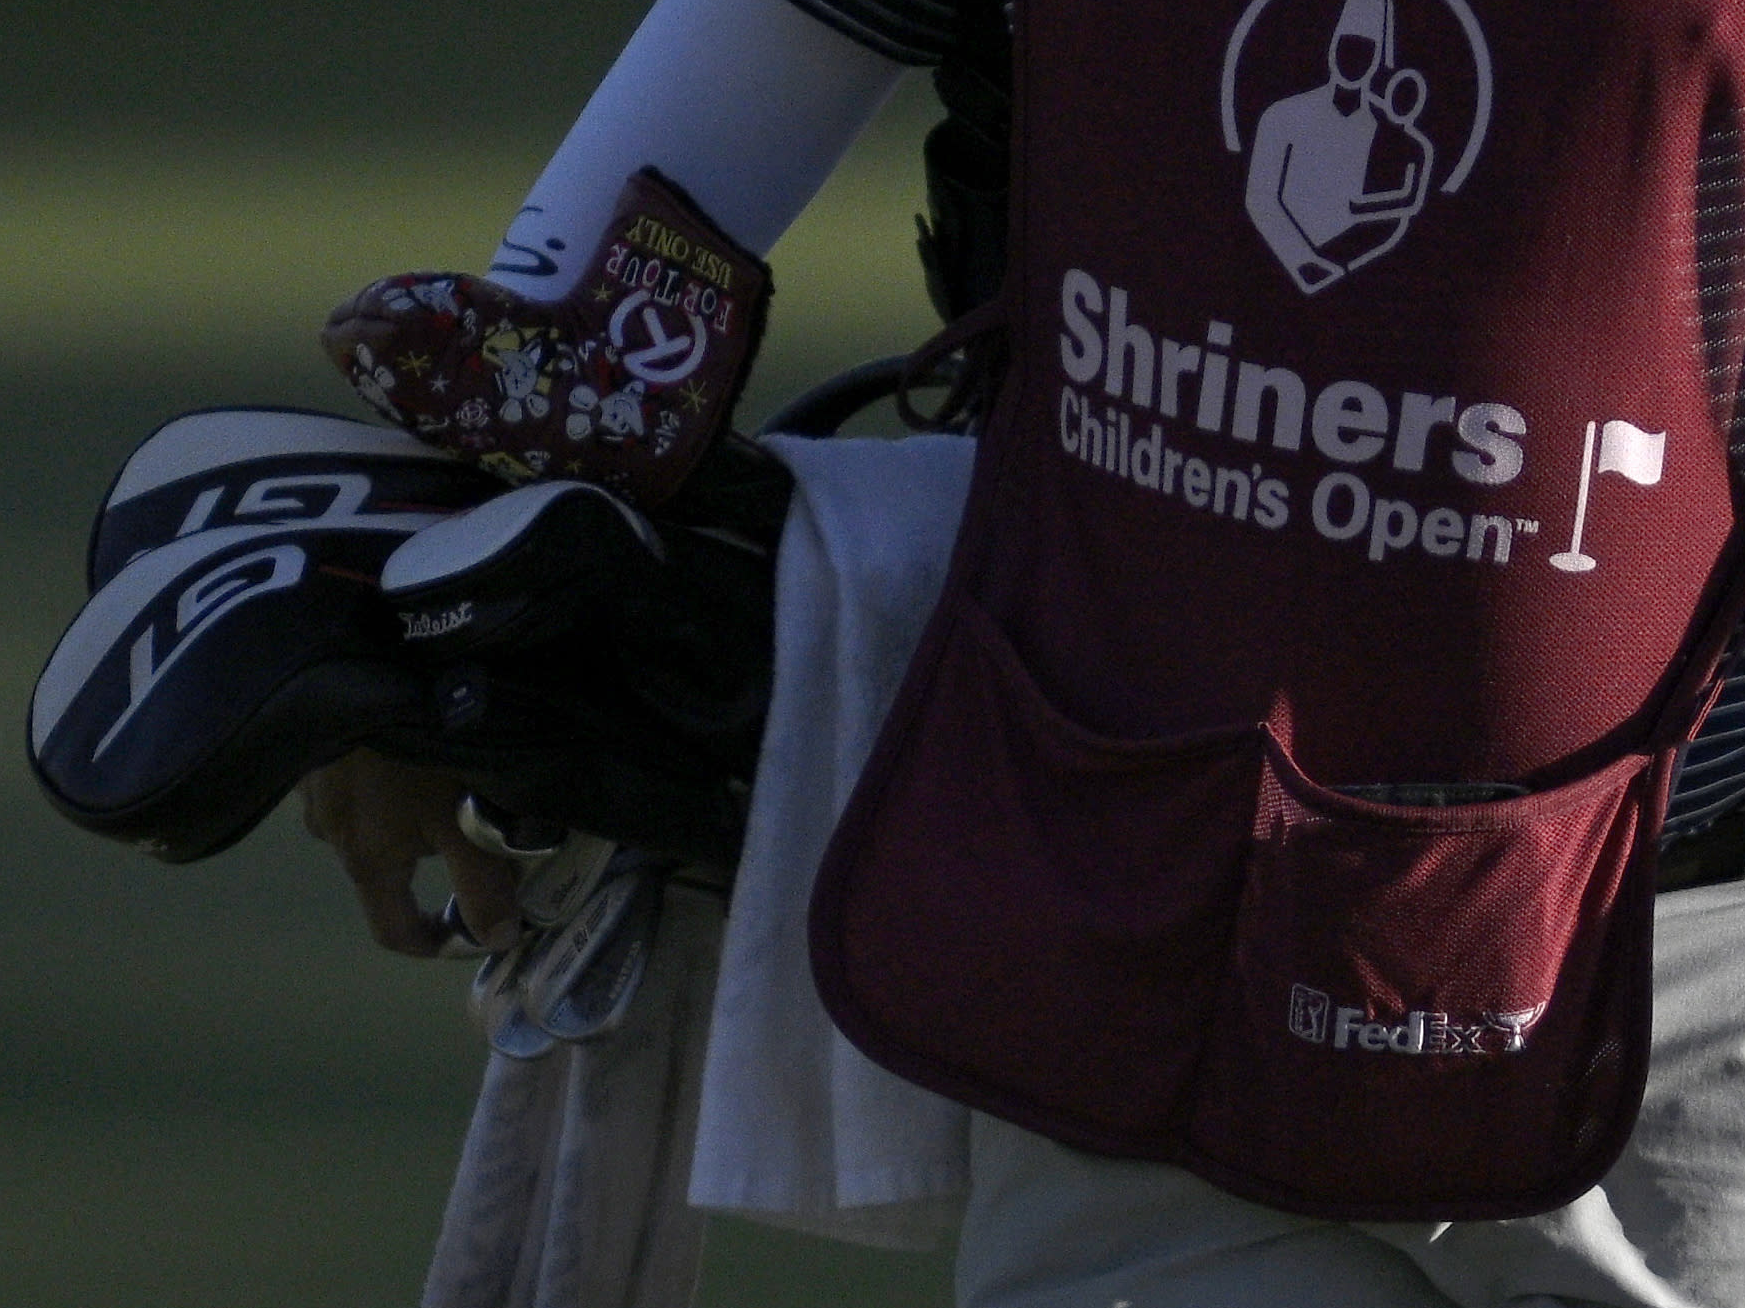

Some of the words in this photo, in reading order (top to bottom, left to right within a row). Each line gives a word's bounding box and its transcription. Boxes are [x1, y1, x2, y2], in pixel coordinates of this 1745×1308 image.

[623, 216, 691, 263] ONLY
[605, 242, 681, 308] TOUR
[1059, 267, 1527, 486] Shriners
[1059, 385, 1290, 530] Children's
[1333, 1006, 1486, 1055] FedEx
